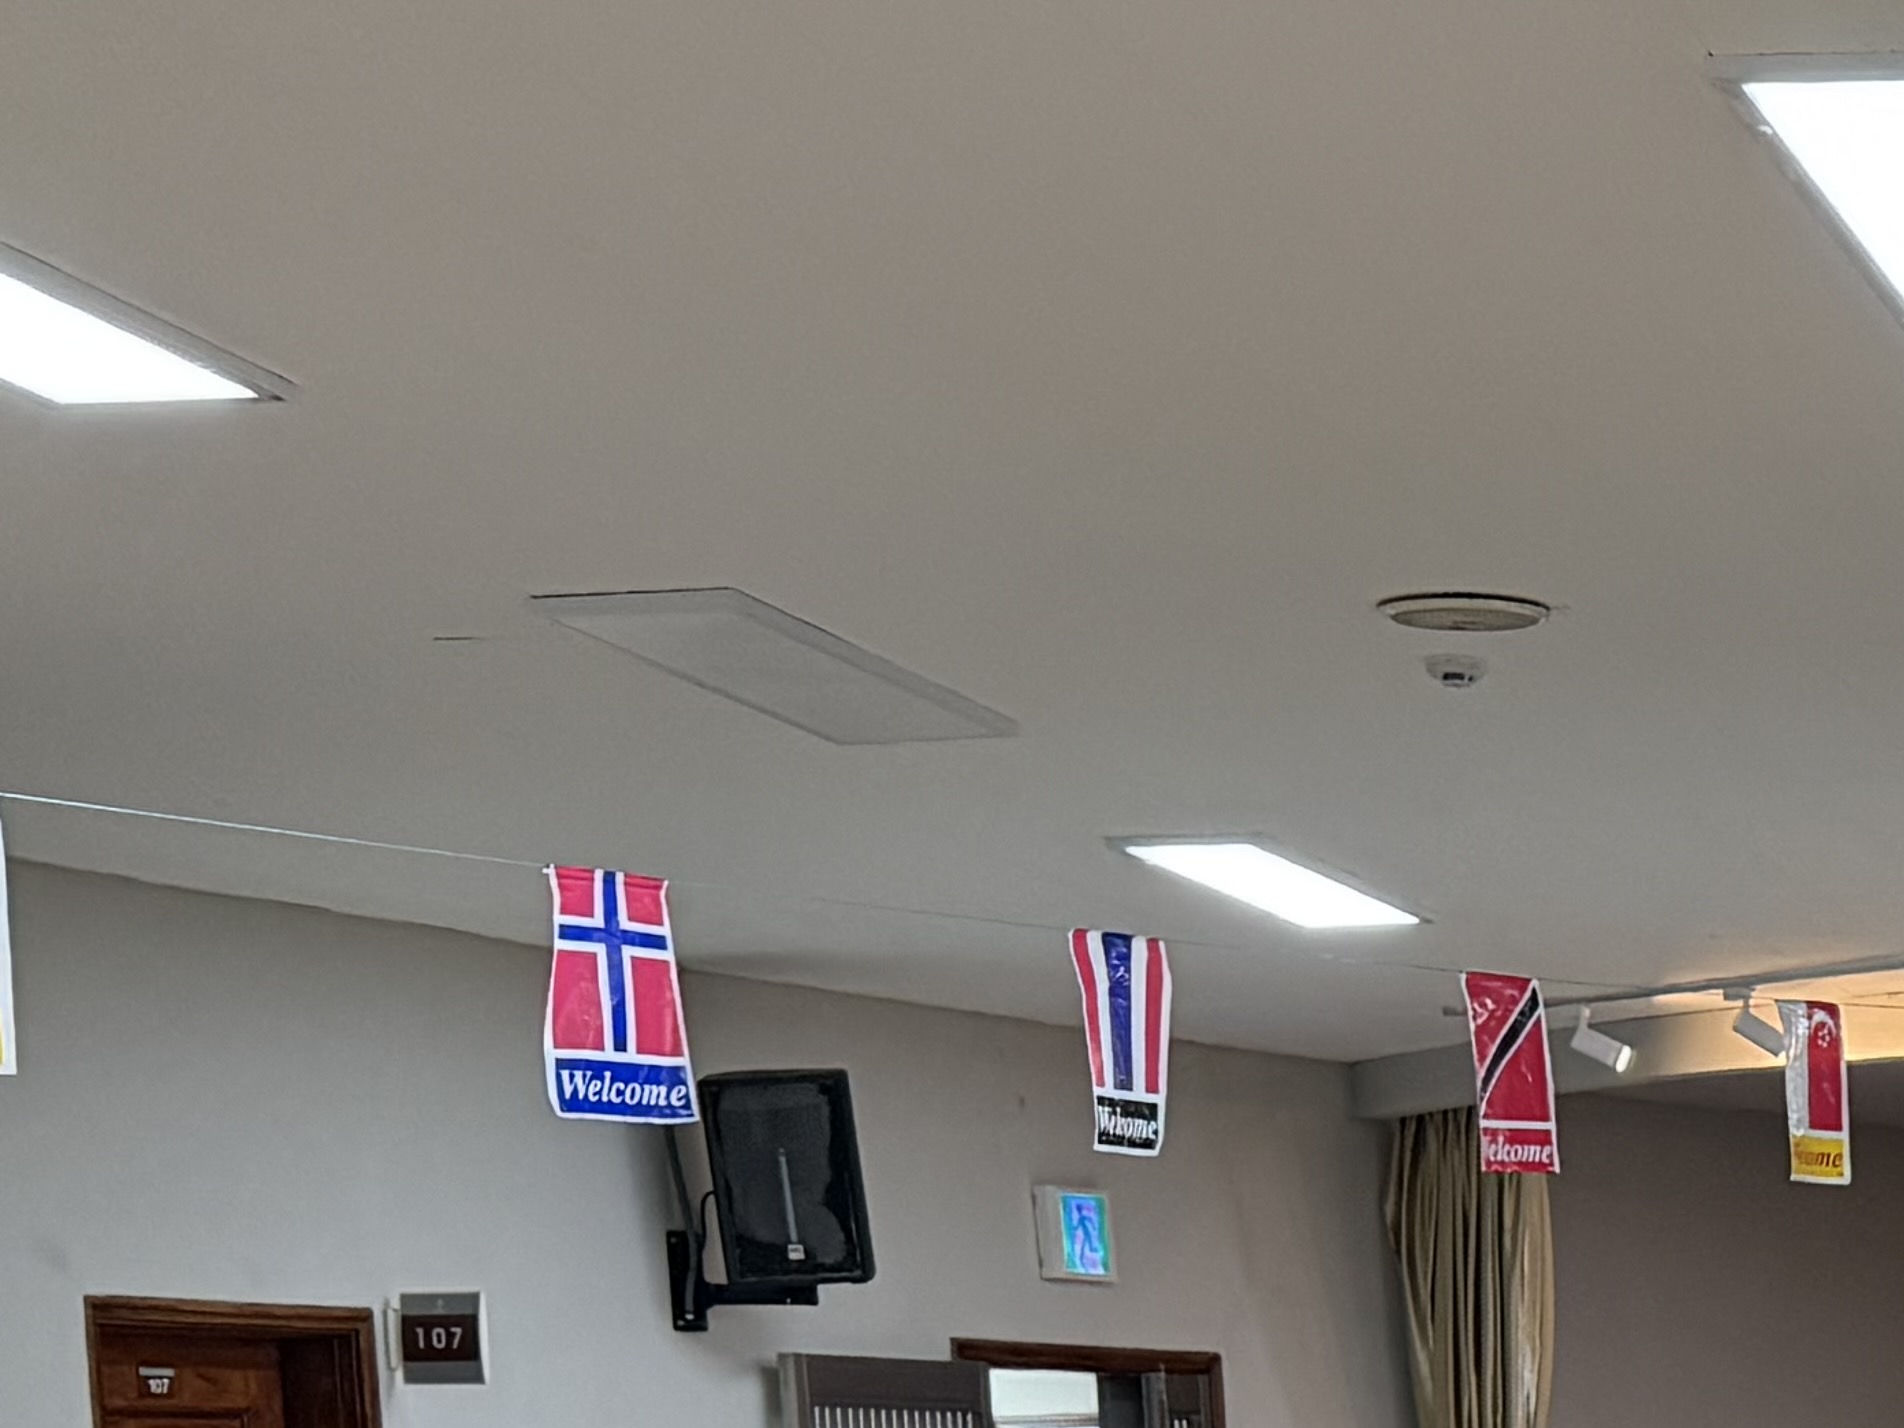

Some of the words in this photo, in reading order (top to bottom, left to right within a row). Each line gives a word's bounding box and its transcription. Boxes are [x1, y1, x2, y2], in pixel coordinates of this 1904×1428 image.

[560, 1069, 687, 1107] Welcome
[415, 1327, 463, 1350] 107
[148, 1378, 170, 1394] 107
